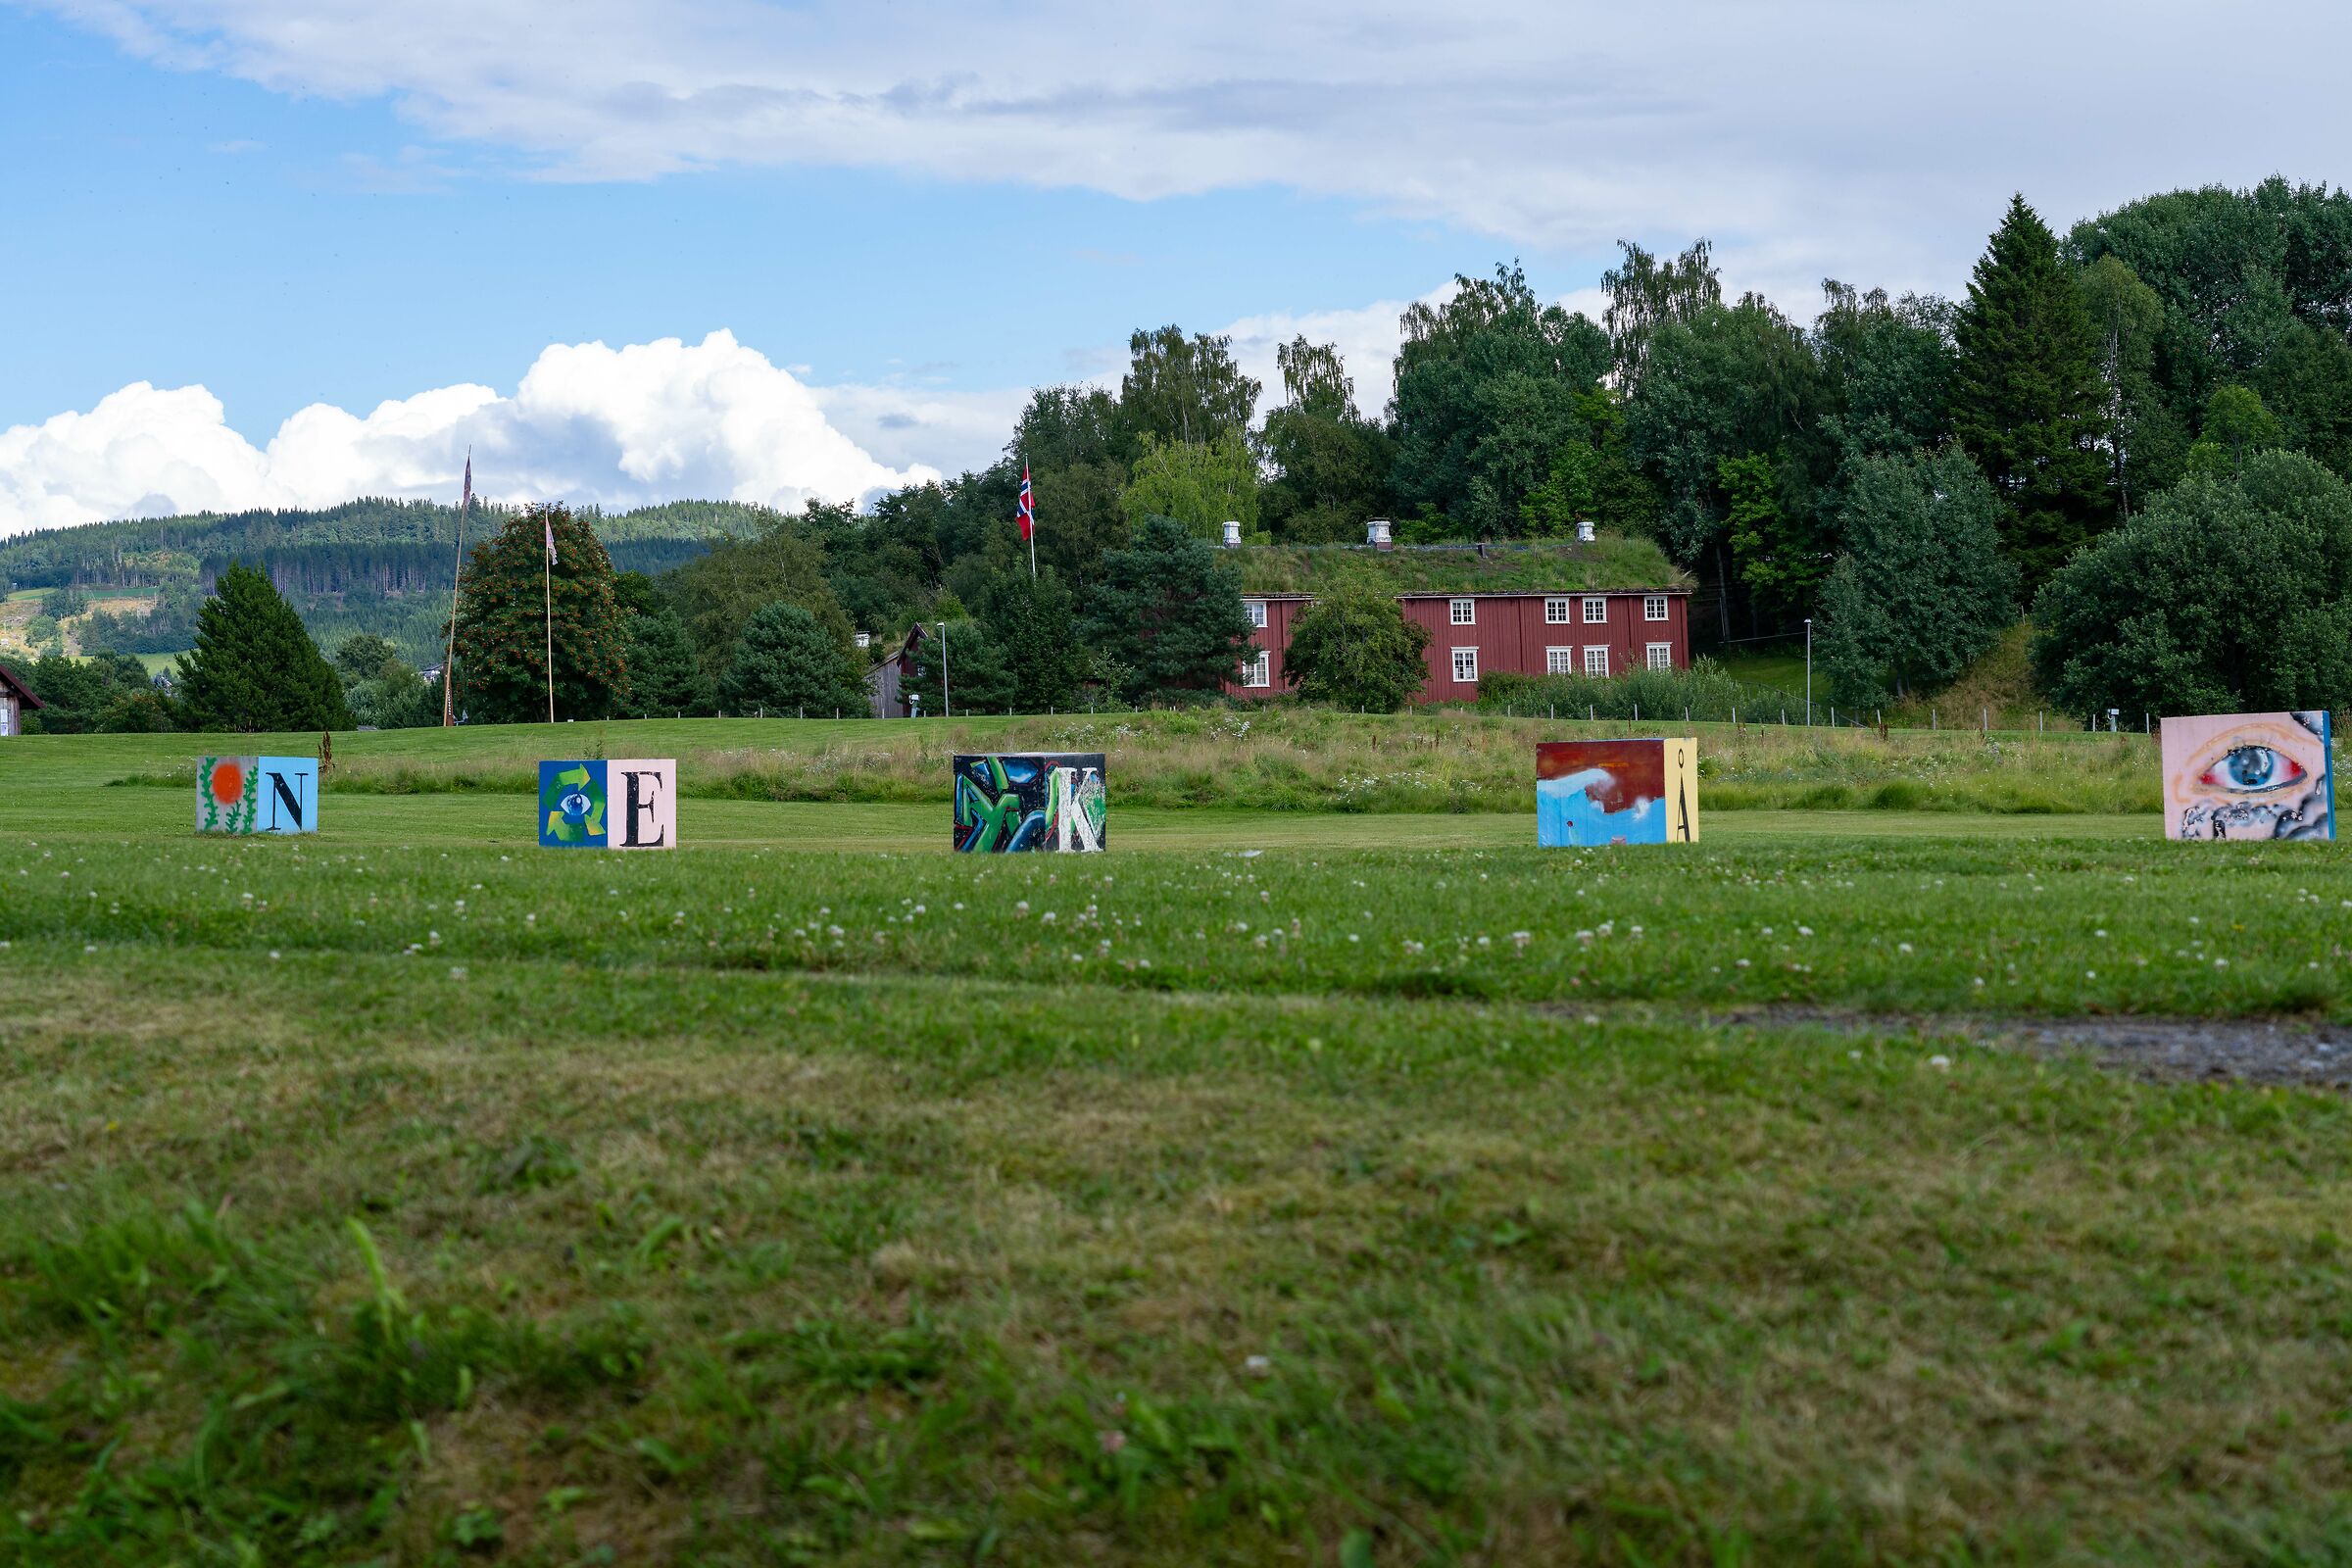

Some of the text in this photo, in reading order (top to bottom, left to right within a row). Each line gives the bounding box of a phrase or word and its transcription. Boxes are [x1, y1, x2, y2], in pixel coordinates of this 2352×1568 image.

[266, 772, 309, 830] N
[619, 771, 664, 847] E
[1055, 767, 1104, 854] K
